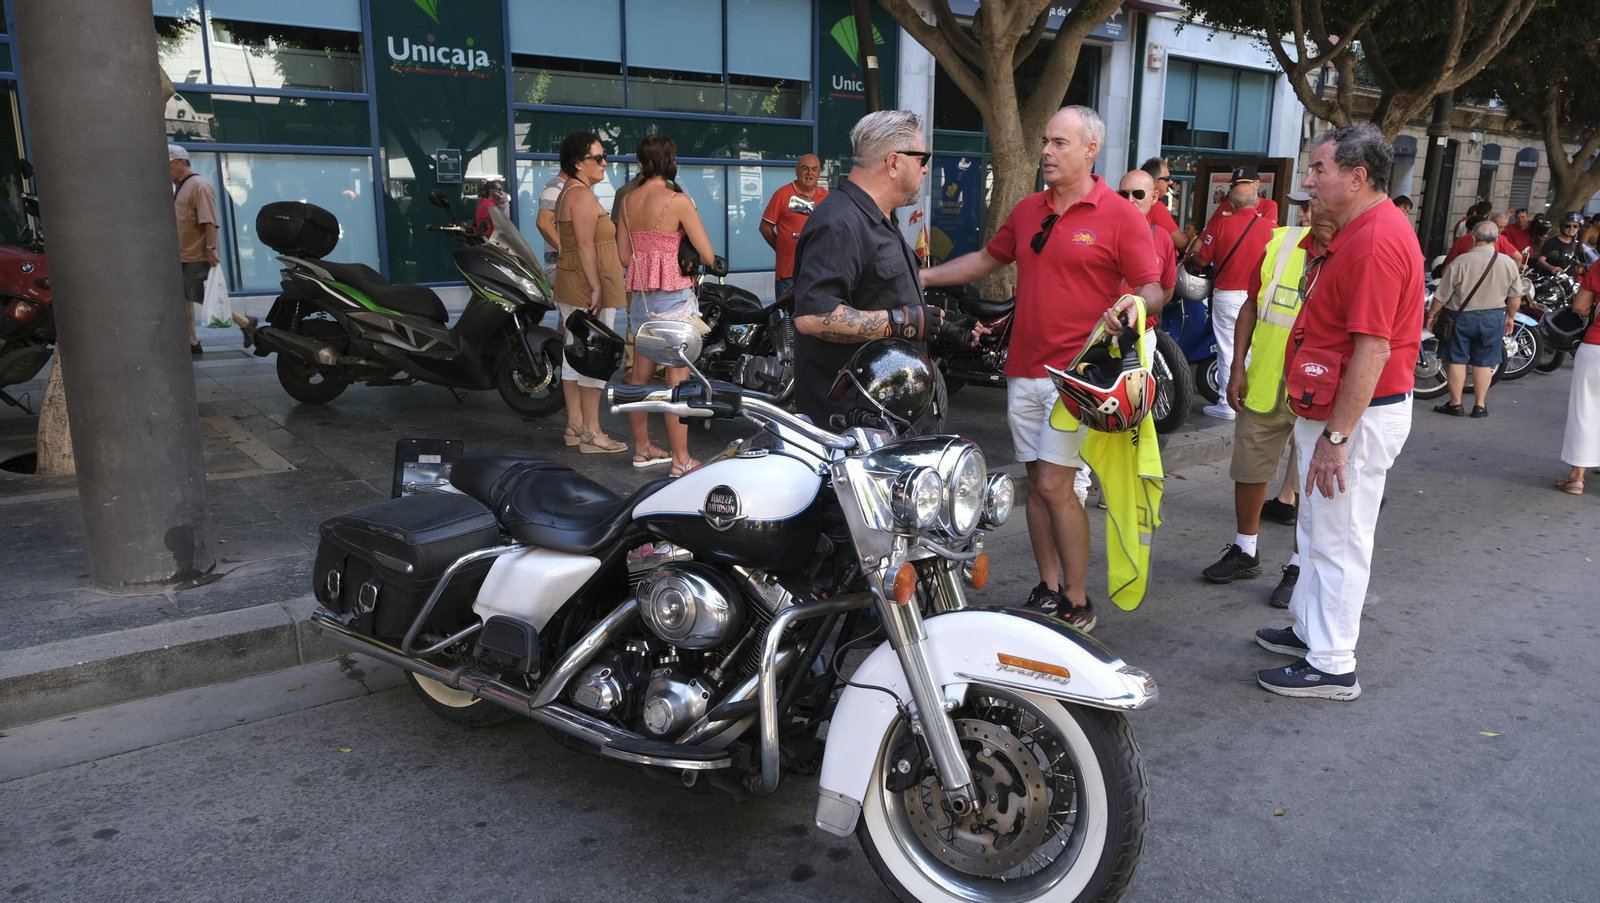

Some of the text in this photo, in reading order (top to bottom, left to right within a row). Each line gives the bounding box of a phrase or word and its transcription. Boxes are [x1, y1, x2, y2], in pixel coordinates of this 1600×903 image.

[1057, 6, 1066, 17] de
[387, 34, 490, 72] Unicaja
[832, 73, 864, 92] Unic
